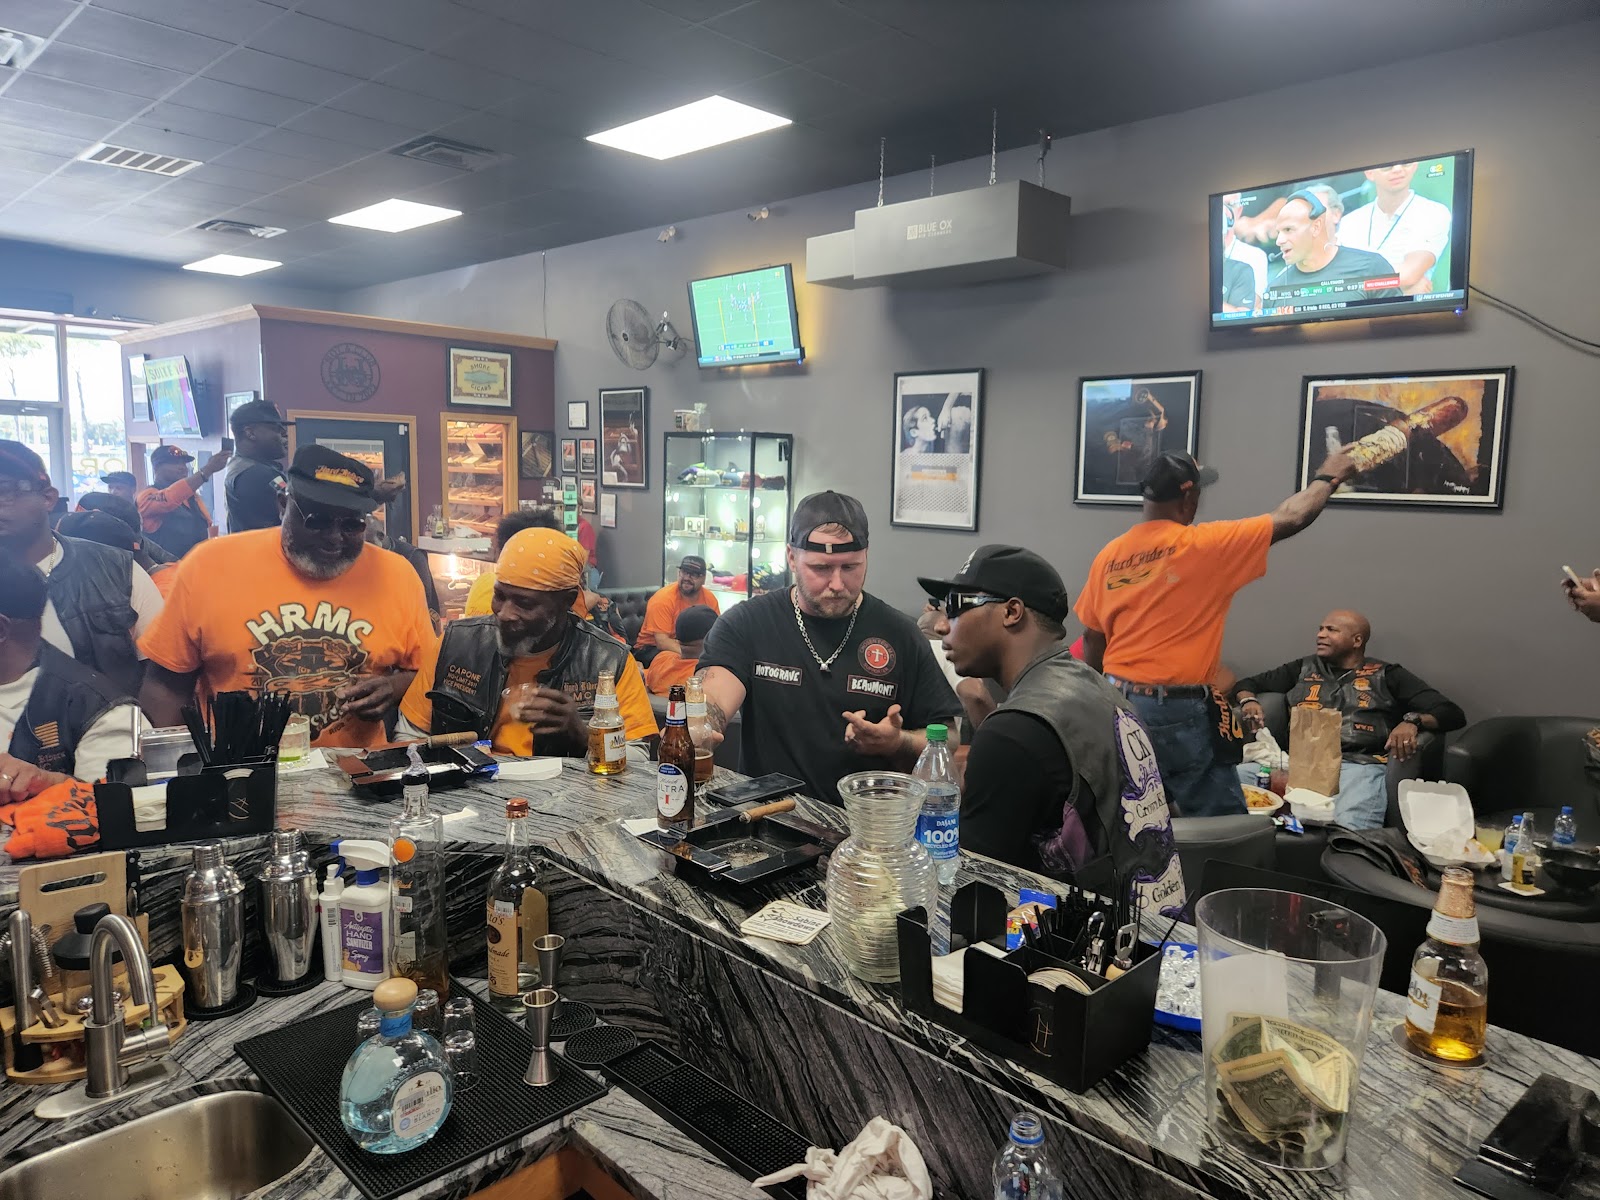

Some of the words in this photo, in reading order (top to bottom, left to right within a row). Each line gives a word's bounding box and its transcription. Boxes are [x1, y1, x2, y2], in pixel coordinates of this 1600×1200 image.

[919, 221, 937, 233] BLUE
[939, 219, 953, 230] OX
[149, 365, 174, 380] SUITE
[1105, 554, 1135, 575] Hard
[1132, 546, 1176, 571] Riders
[246, 602, 373, 645] HRMC
[449, 664, 481, 683] CAPONE
[453, 682, 477, 696] PRESIDENT
[851, 678, 894, 696] BEAUMONT
[1126, 729, 1152, 762] CK
[1135, 802, 1158, 819] Crown
[936, 819, 957, 827] DASANI
[1152, 879, 1181, 903] Golden
[773, 915, 816, 932] Showdown
[793, 915, 822, 928] Sabine
[346, 930, 373, 941] HAND
[346, 937, 373, 950] SANITIZER
[350, 950, 369, 963] Spray
[413, 1107, 440, 1123] BLANCO
